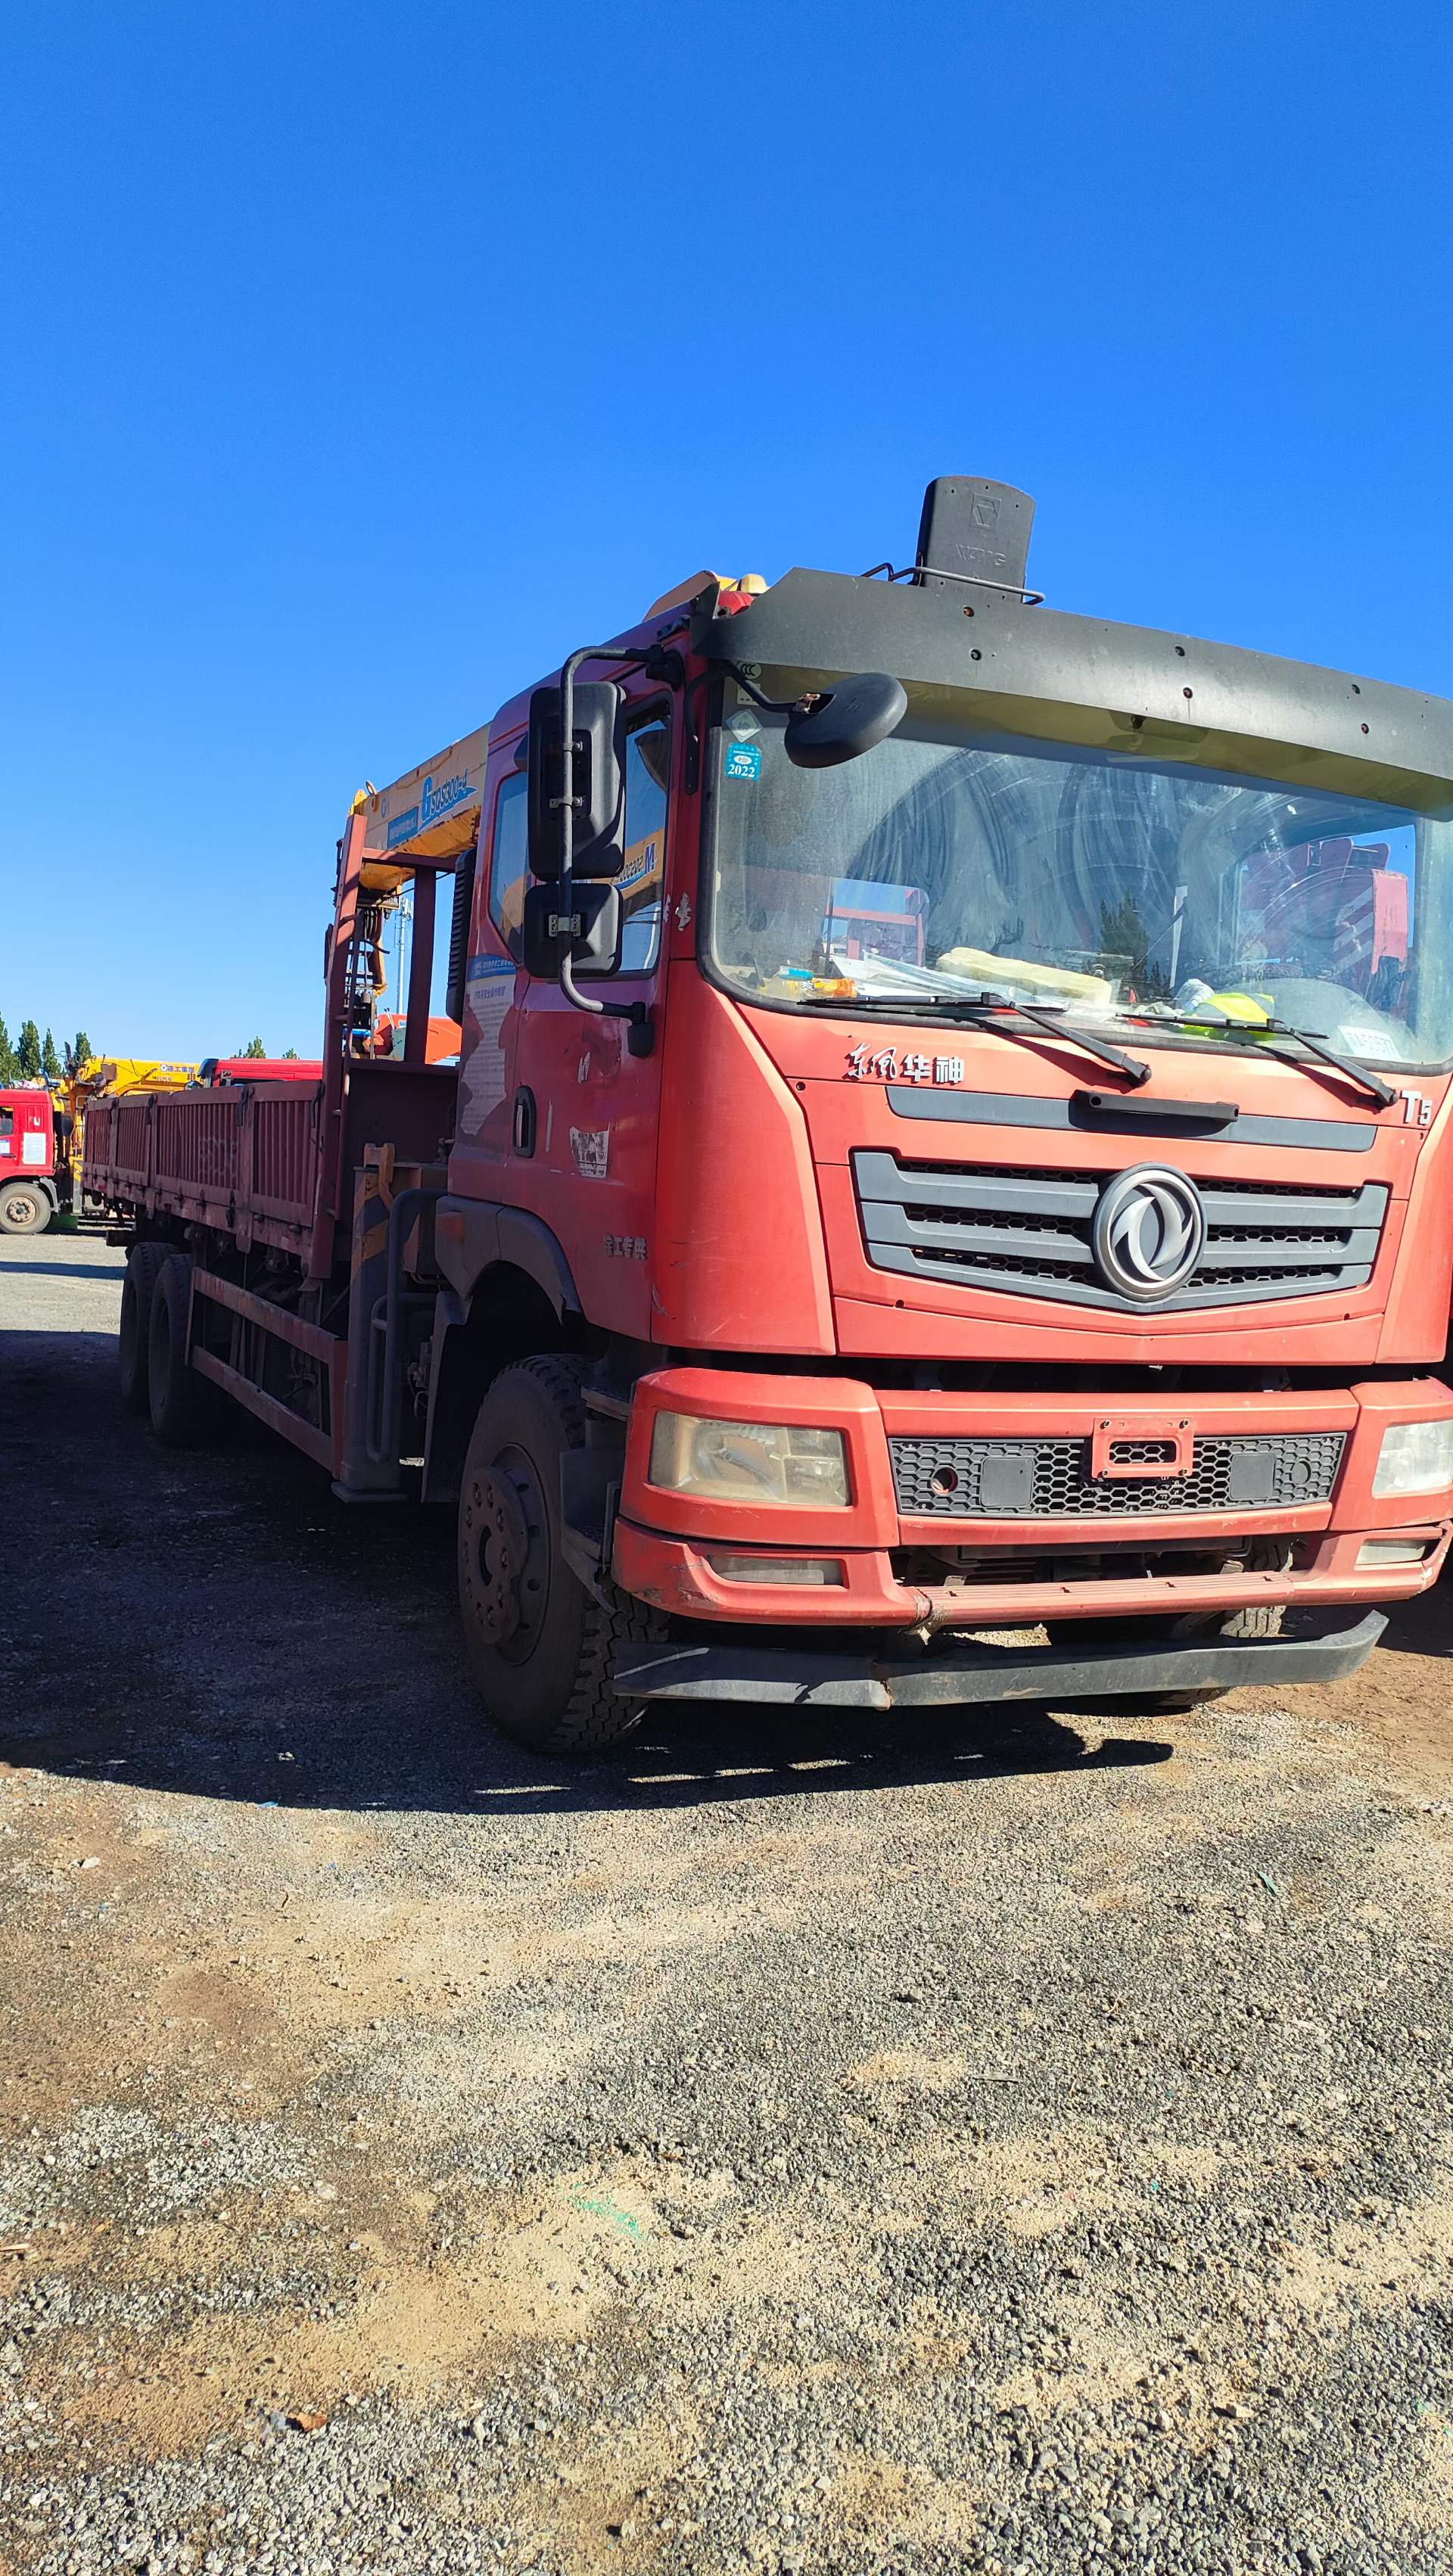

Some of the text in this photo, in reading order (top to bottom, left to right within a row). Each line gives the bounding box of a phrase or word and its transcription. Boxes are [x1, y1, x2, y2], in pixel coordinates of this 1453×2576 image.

[727, 764, 755, 778] 2022
[846, 1042, 965, 1084] 东风华神
[1400, 1090, 1433, 1125] T5
